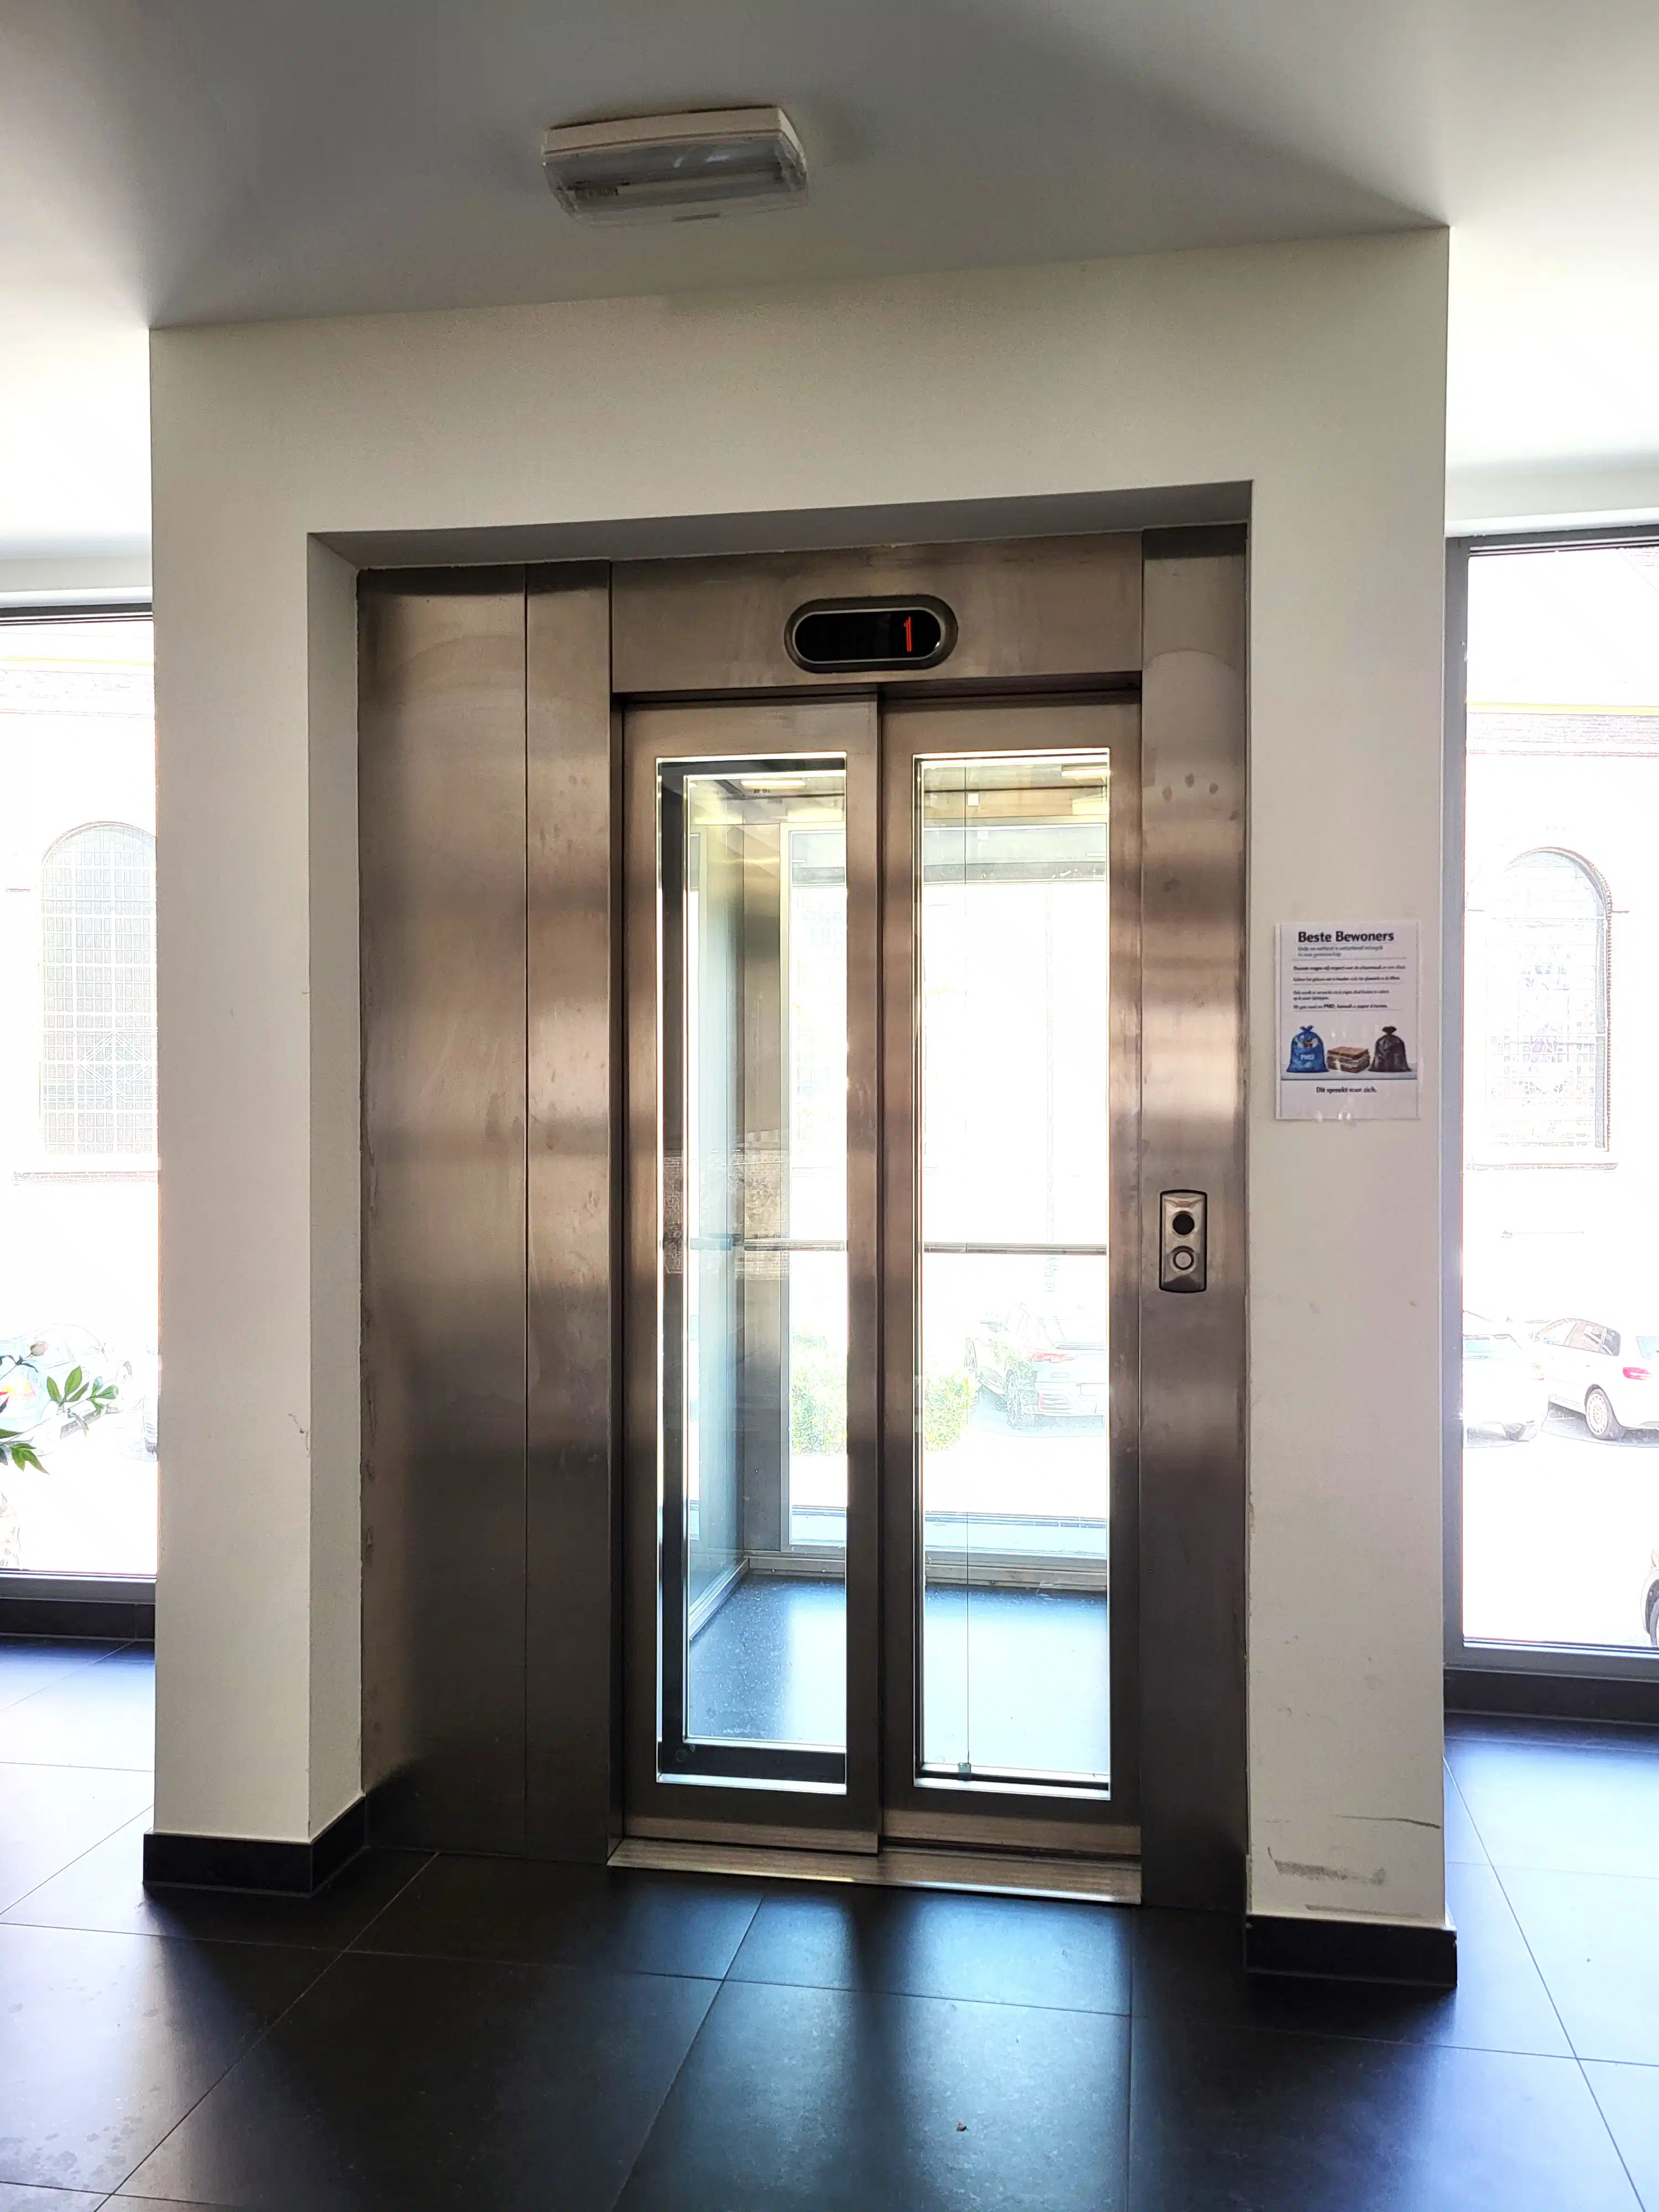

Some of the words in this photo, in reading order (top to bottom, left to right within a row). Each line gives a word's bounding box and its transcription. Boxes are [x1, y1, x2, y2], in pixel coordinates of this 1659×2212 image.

[904, 615, 912, 653] 1
[1298, 931, 1332, 943] Beste
[1335, 930, 1395, 942] Bewoners
[1326, 1086, 1348, 1094] spreekt
